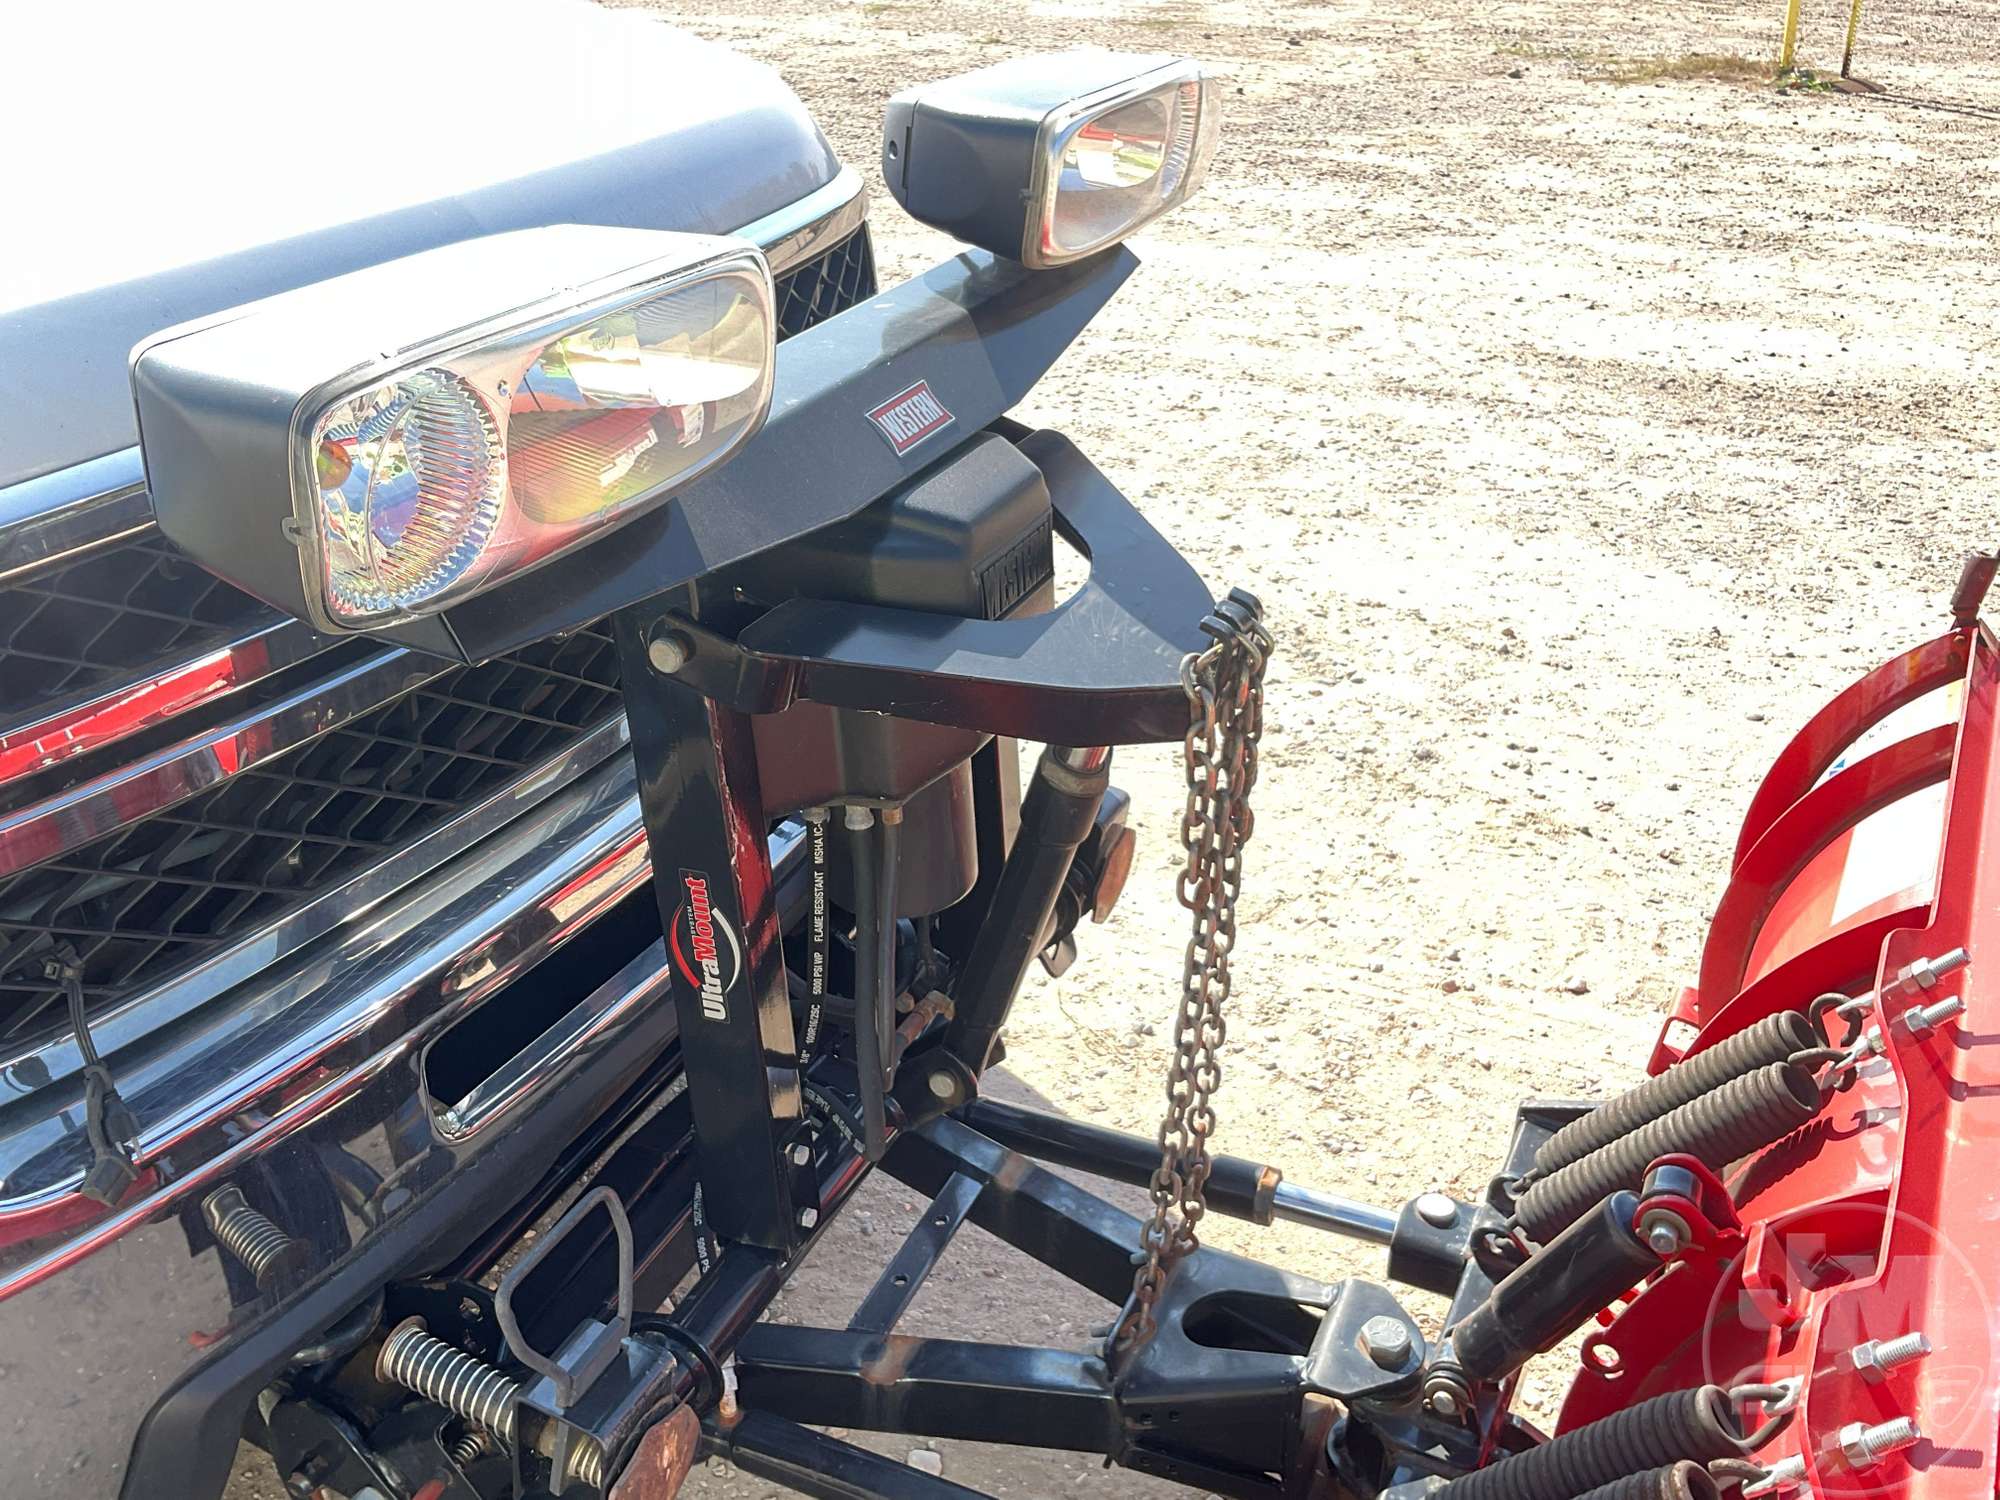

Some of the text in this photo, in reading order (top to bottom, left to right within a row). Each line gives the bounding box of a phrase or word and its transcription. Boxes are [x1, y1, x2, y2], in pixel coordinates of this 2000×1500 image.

[878, 390, 944, 443] WESTERN
[981, 520, 1052, 620] WESTERN
[814, 838, 824, 865] MSHA
[814, 871, 825, 915] RESISTANT
[688, 905, 697, 935] SYSTEM
[814, 915, 824, 942] FLAME
[685, 876, 727, 1021] UltraMount
[813, 952, 824, 966] WP
[813, 966, 824, 978] PSI
[813, 978, 823, 995] 5000
